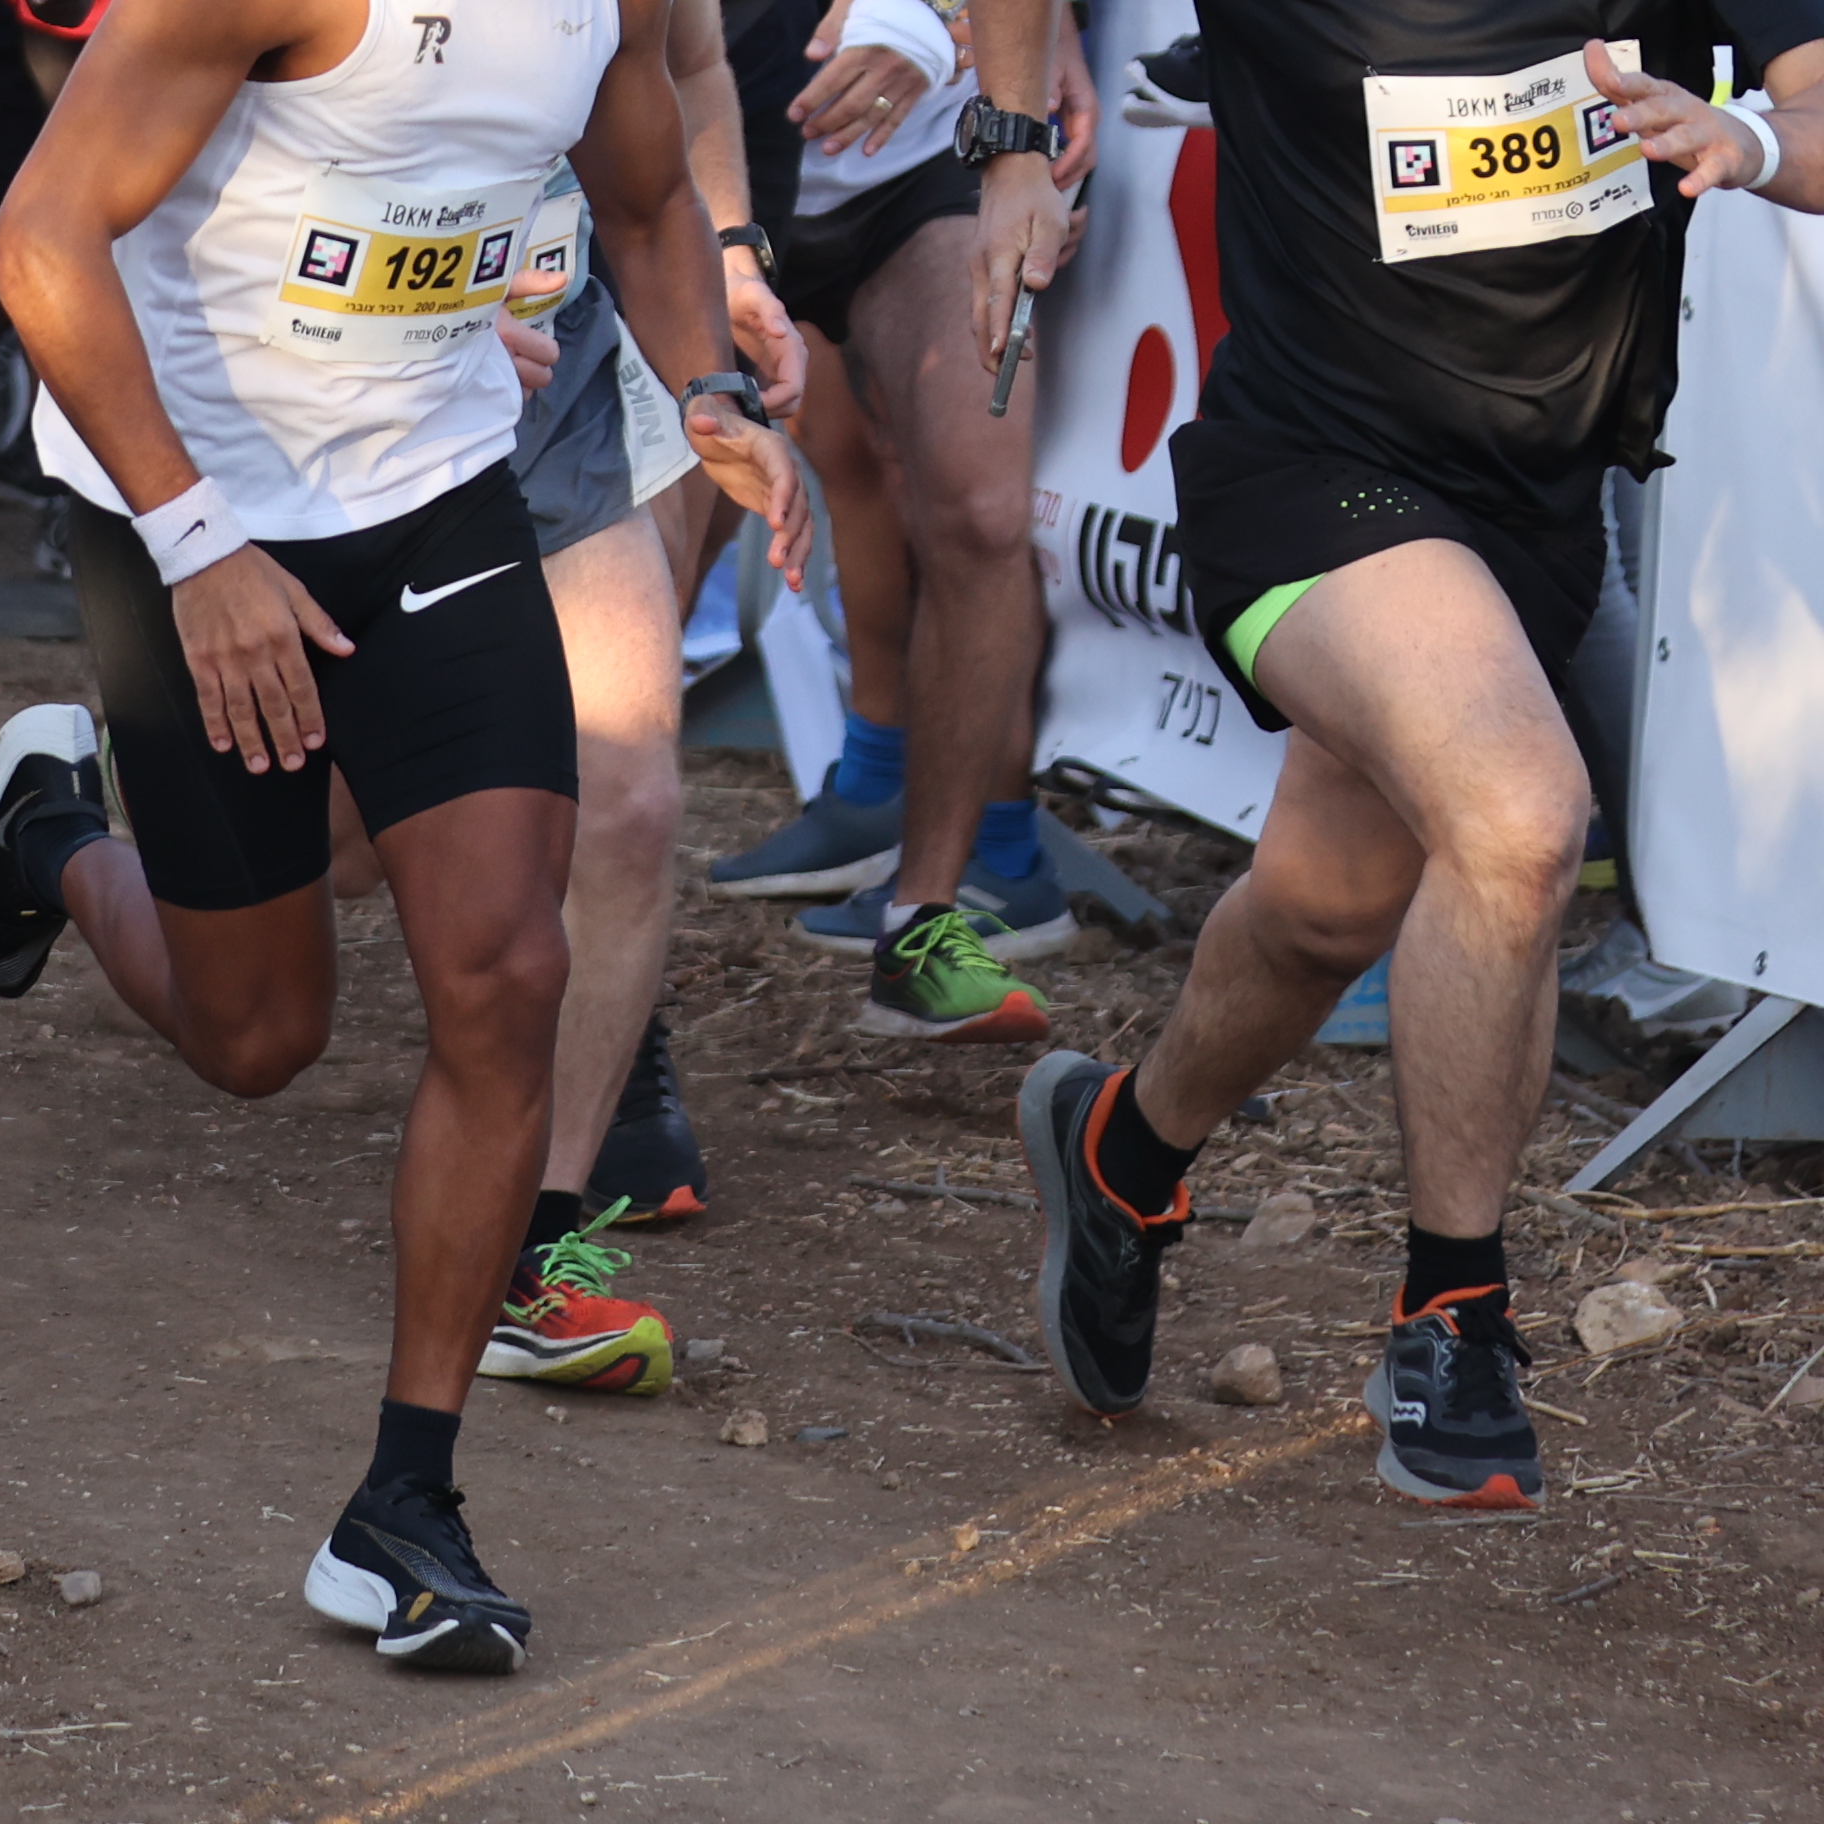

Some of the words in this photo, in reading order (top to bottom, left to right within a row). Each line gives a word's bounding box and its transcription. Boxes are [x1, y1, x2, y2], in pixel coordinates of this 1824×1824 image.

[1447, 97, 1497, 118] 10KM
[1469, 124, 1561, 178] 389
[1523, 183, 1552, 196] דניה
[1555, 169, 1591, 191] קבוצת
[381, 202, 433, 228] 10KM
[1531, 207, 1564, 223] צמרת
[1405, 222, 1458, 238] CivilEng
[385, 245, 464, 291] 192
[414, 301, 437, 313] 200
[292, 318, 343, 341] CivilEng
[1079, 501, 1195, 637] פקון
